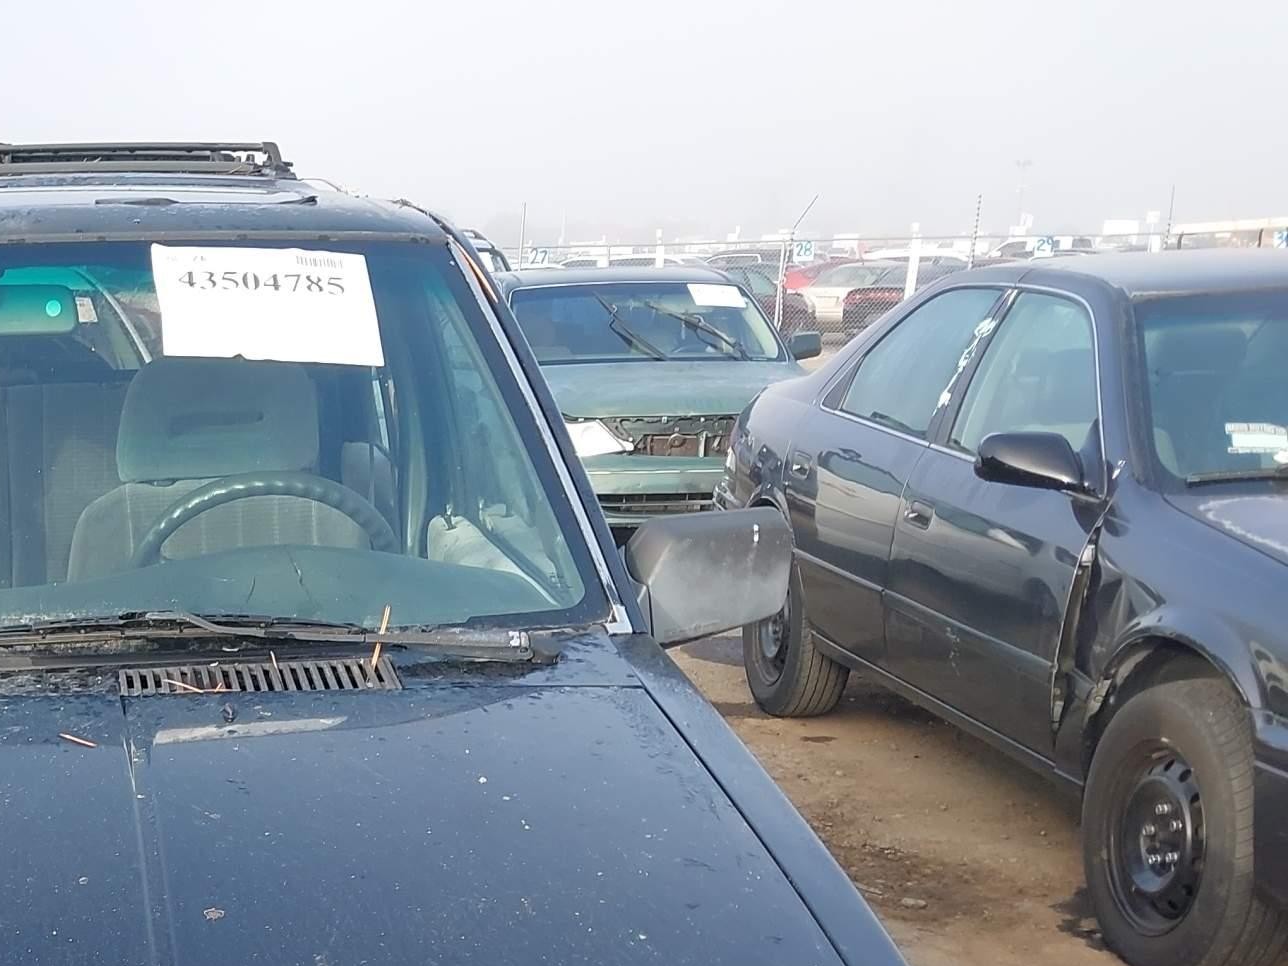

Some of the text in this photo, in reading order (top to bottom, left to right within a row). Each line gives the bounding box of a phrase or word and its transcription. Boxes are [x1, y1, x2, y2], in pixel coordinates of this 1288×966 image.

[795, 240, 813, 257] 28
[1036, 235, 1055, 253] 29
[529, 247, 549, 264] 27
[179, 271, 345, 295] 43504785
